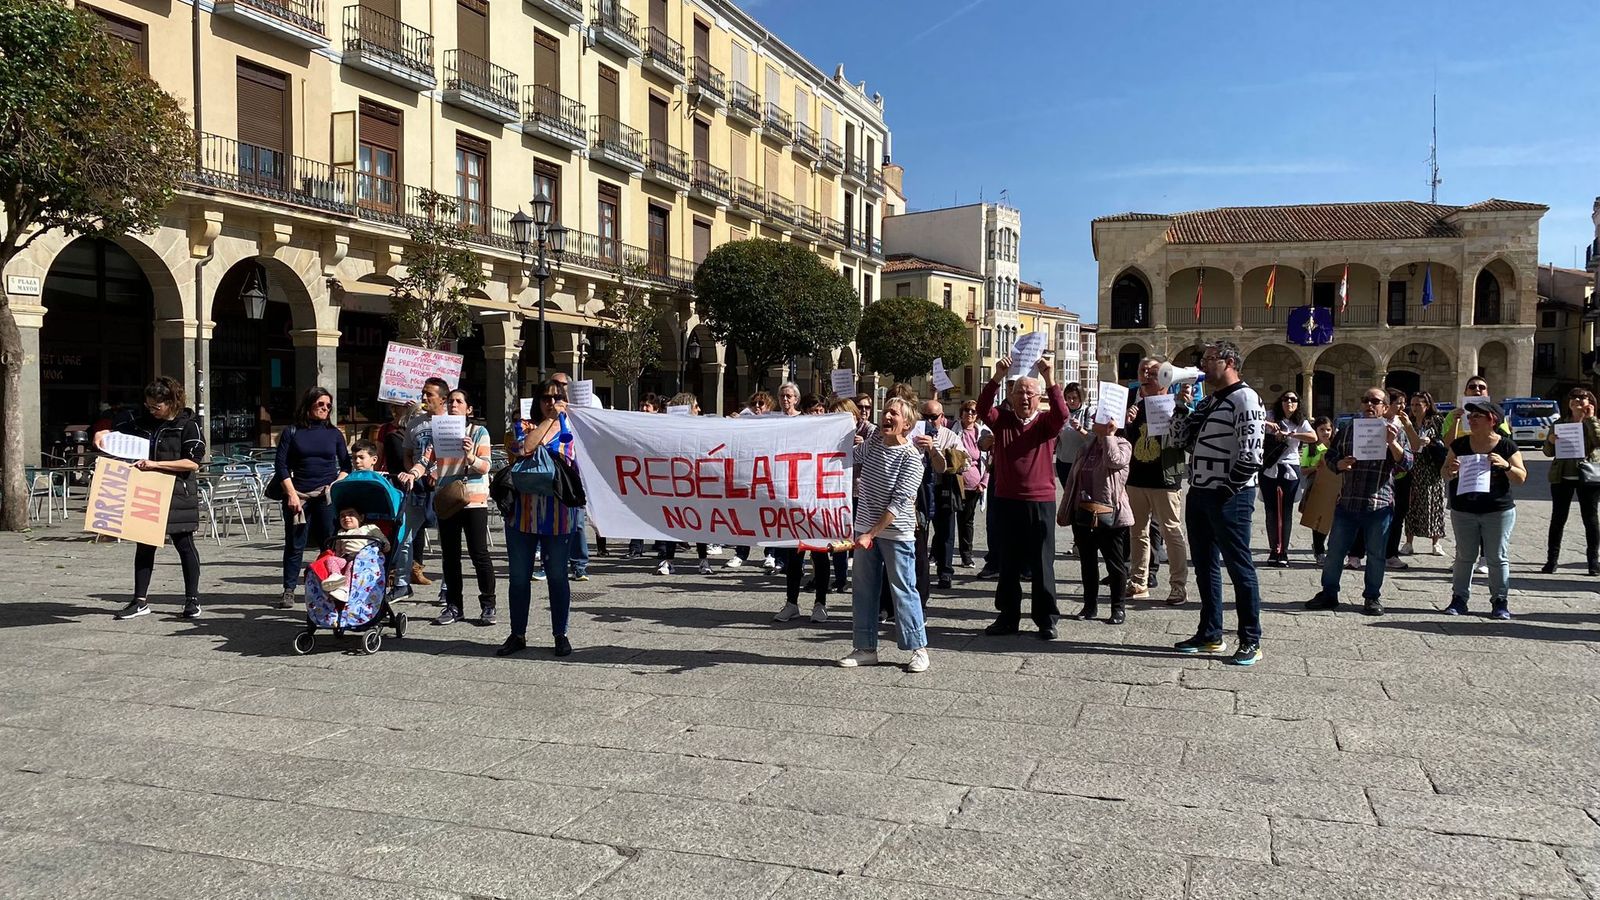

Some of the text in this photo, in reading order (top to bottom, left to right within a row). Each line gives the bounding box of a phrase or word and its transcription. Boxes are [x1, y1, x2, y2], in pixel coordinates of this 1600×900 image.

[386, 357, 396, 365] EL
[388, 344, 397, 352] EL
[398, 347, 419, 356] FUTURO
[615, 443, 847, 500] REBÉLATE
[92, 463, 131, 534] PARKNG
[131, 486, 161, 523] NO
[662, 505, 851, 539] NO AL PARKING
